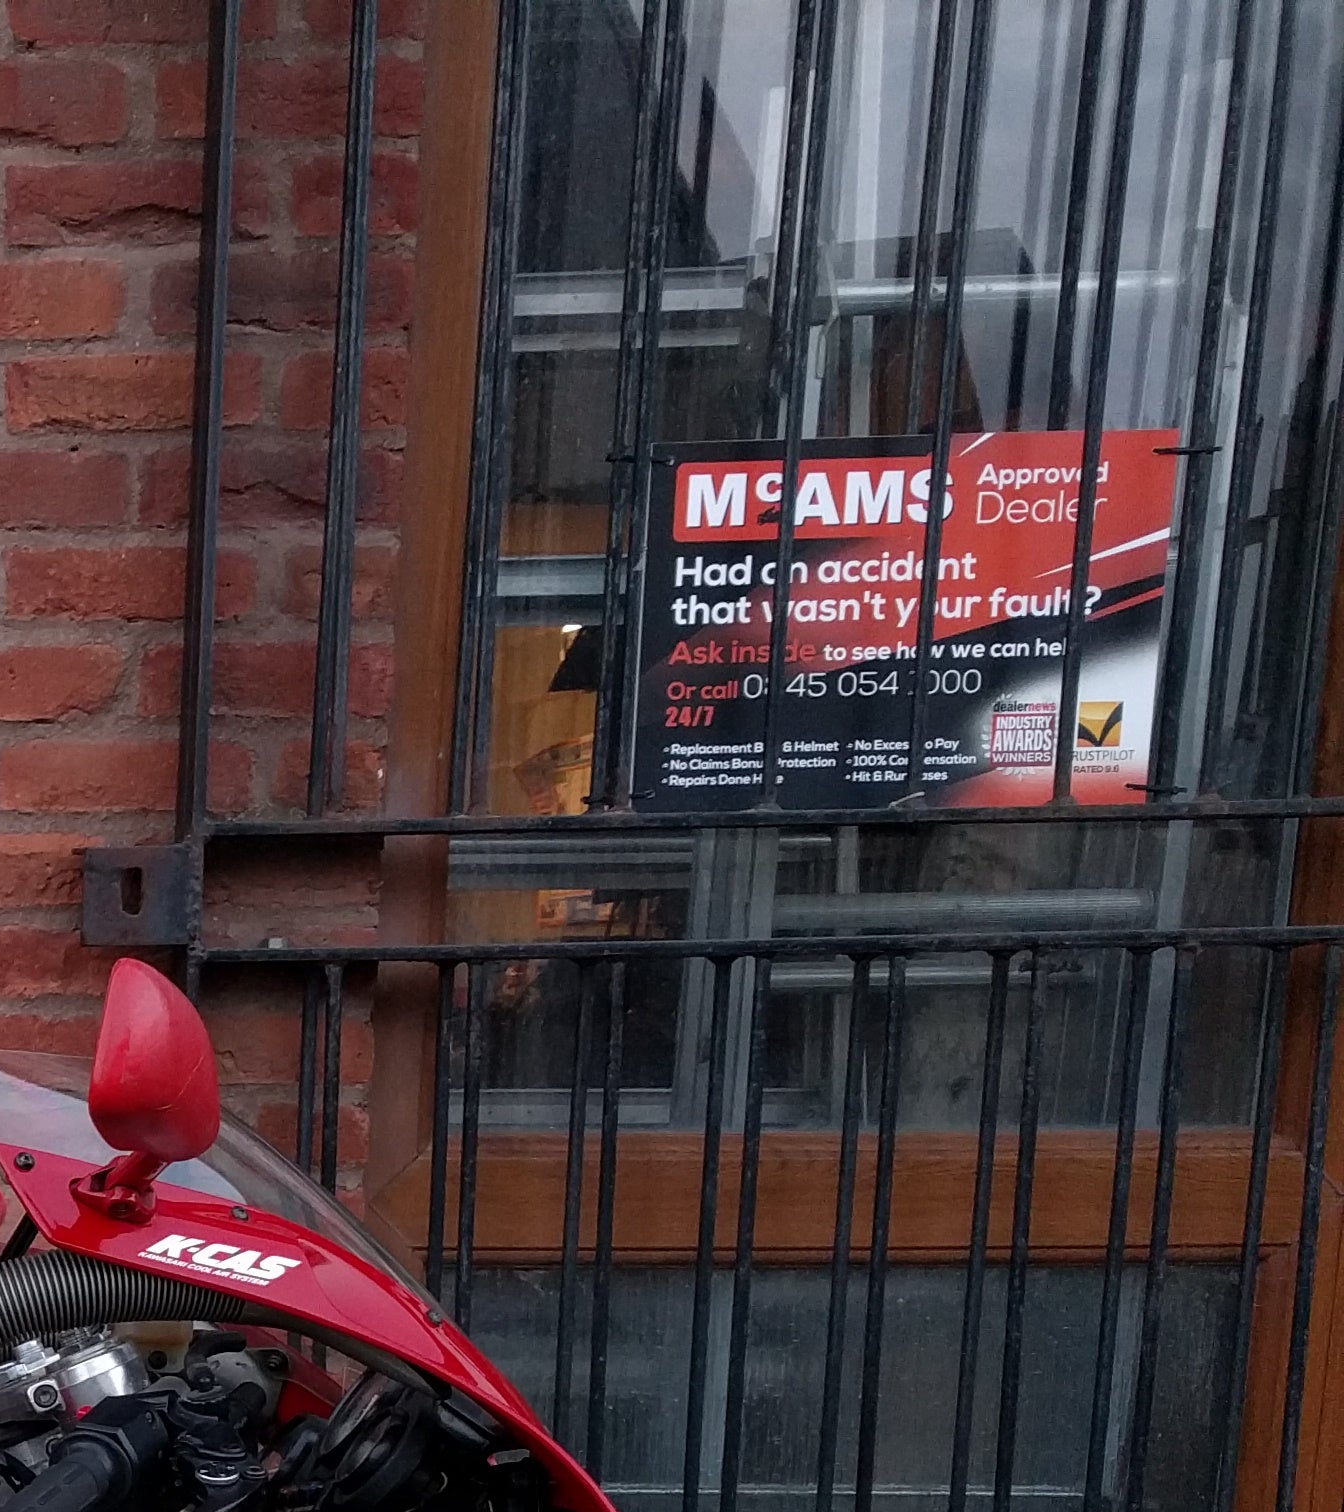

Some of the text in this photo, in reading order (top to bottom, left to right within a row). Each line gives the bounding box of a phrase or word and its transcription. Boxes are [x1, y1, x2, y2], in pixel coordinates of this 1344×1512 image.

[977, 461, 1109, 490] Approvd
[675, 555, 753, 587] Had
[671, 595, 752, 625] that
[668, 640, 723, 665] Ask
[732, 641, 816, 664] insde
[823, 643, 847, 660] to
[851, 646, 891, 661] see
[952, 644, 984, 658] we
[991, 643, 1030, 657] can
[1035, 638, 1066, 656] hel
[667, 669, 982, 700] Or call 045 054 000
[665, 705, 714, 727] 24/7
[996, 715, 1052, 729] INDUSTRY
[855, 740, 871, 751] No
[873, 739, 910, 750] Exces
[935, 739, 960, 751] Pay
[994, 730, 1053, 751] AWARDS
[670, 743, 751, 757] Replacement
[795, 741, 839, 752] Helmet
[992, 751, 1051, 763] WINNERS
[1072, 749, 1135, 761] RUSTPILOT
[670, 759, 687, 770] No
[689, 758, 730, 770] Claims
[732, 758, 764, 769] Bonu
[852, 754, 977, 767] 100% Coensation
[668, 774, 716, 788] Repairs
[718, 773, 751, 785] Done
[852, 771, 871, 782] Hit
[146, 1233, 303, 1281] K-CAS
